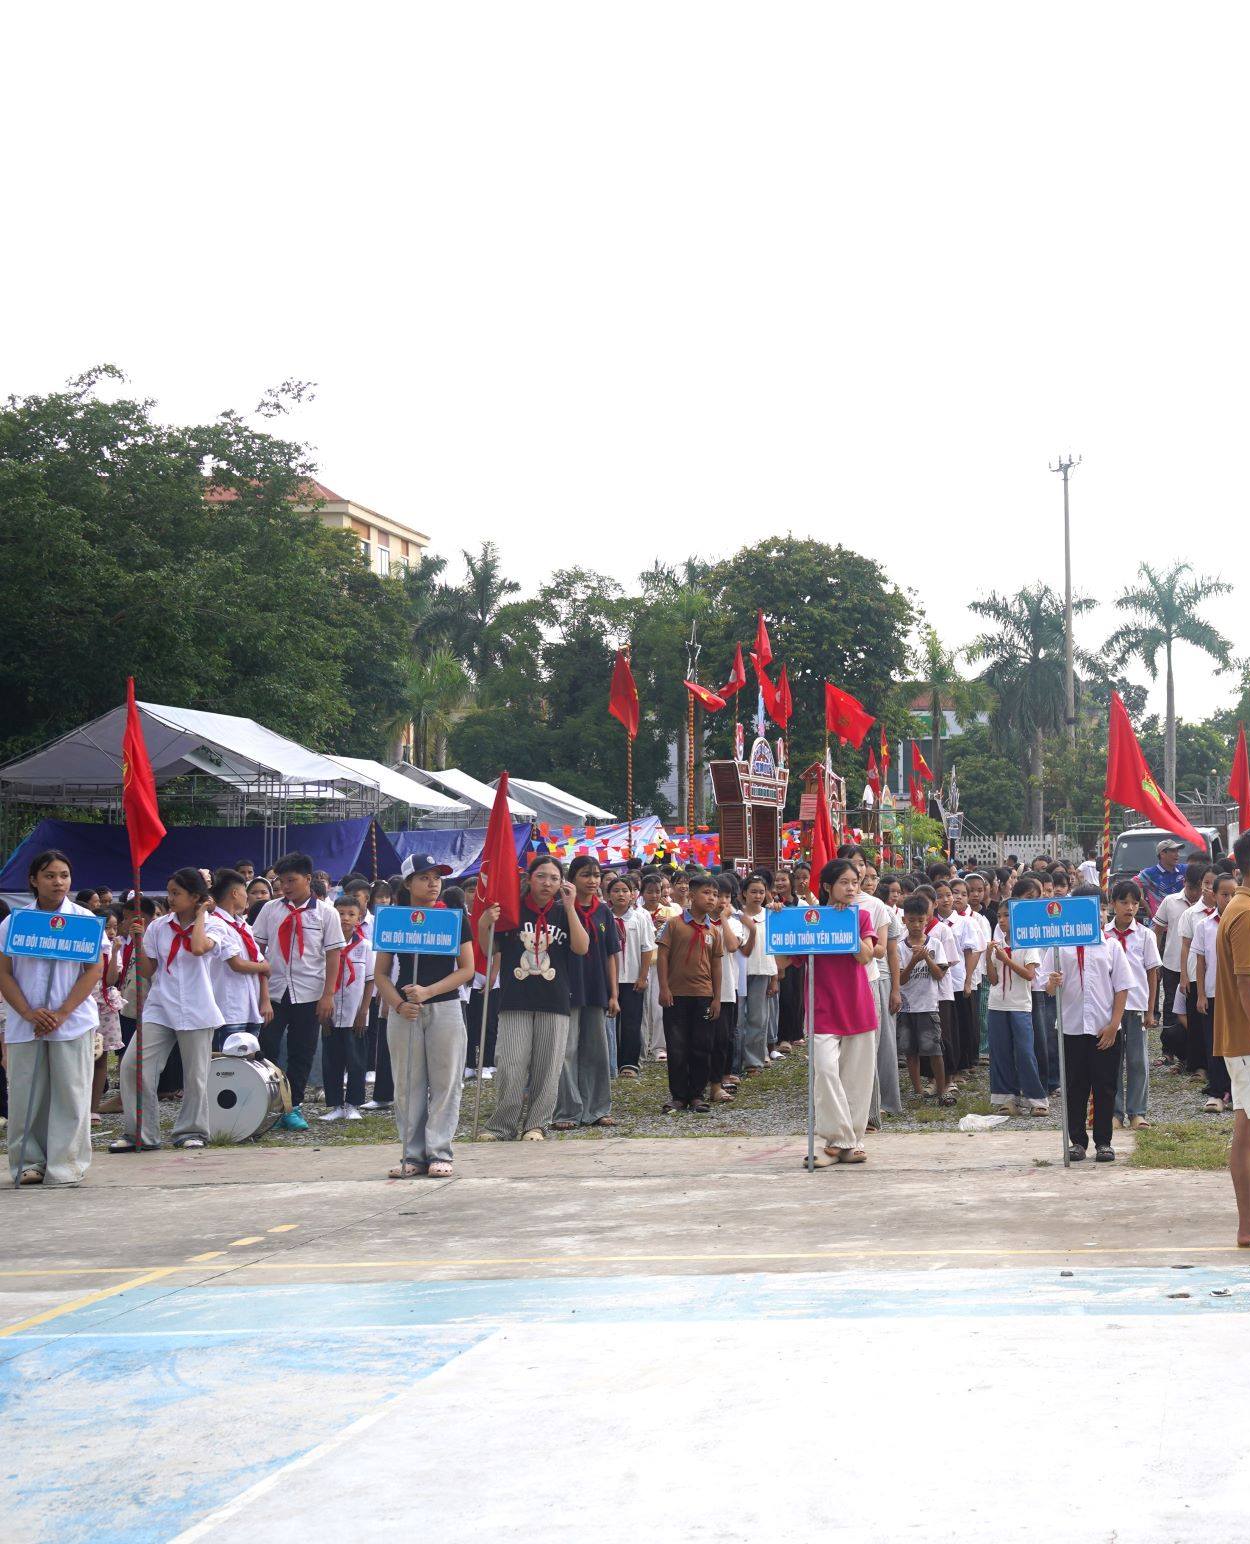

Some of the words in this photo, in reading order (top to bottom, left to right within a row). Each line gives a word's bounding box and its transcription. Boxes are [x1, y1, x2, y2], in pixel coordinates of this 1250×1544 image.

[381, 930, 392, 943] CHI
[393, 929, 405, 946] ĐỘI
[405, 930, 422, 945] THÔN
[771, 933, 783, 946] CHI
[784, 930, 796, 948] ĐỘI
[798, 930, 815, 945] THÔN
[816, 930, 830, 945] YÊN
[1016, 927, 1028, 940] CHI
[1029, 924, 1041, 942] ĐỘI
[1042, 923, 1060, 938] THÔN
[1061, 922, 1075, 937] YÊN
[1076, 921, 1093, 936] BÌNH
[13, 934, 25, 947] CHI
[25, 933, 38, 950] ĐỘI
[39, 935, 56, 950] THÔN
[58, 938, 72, 952] MAI
